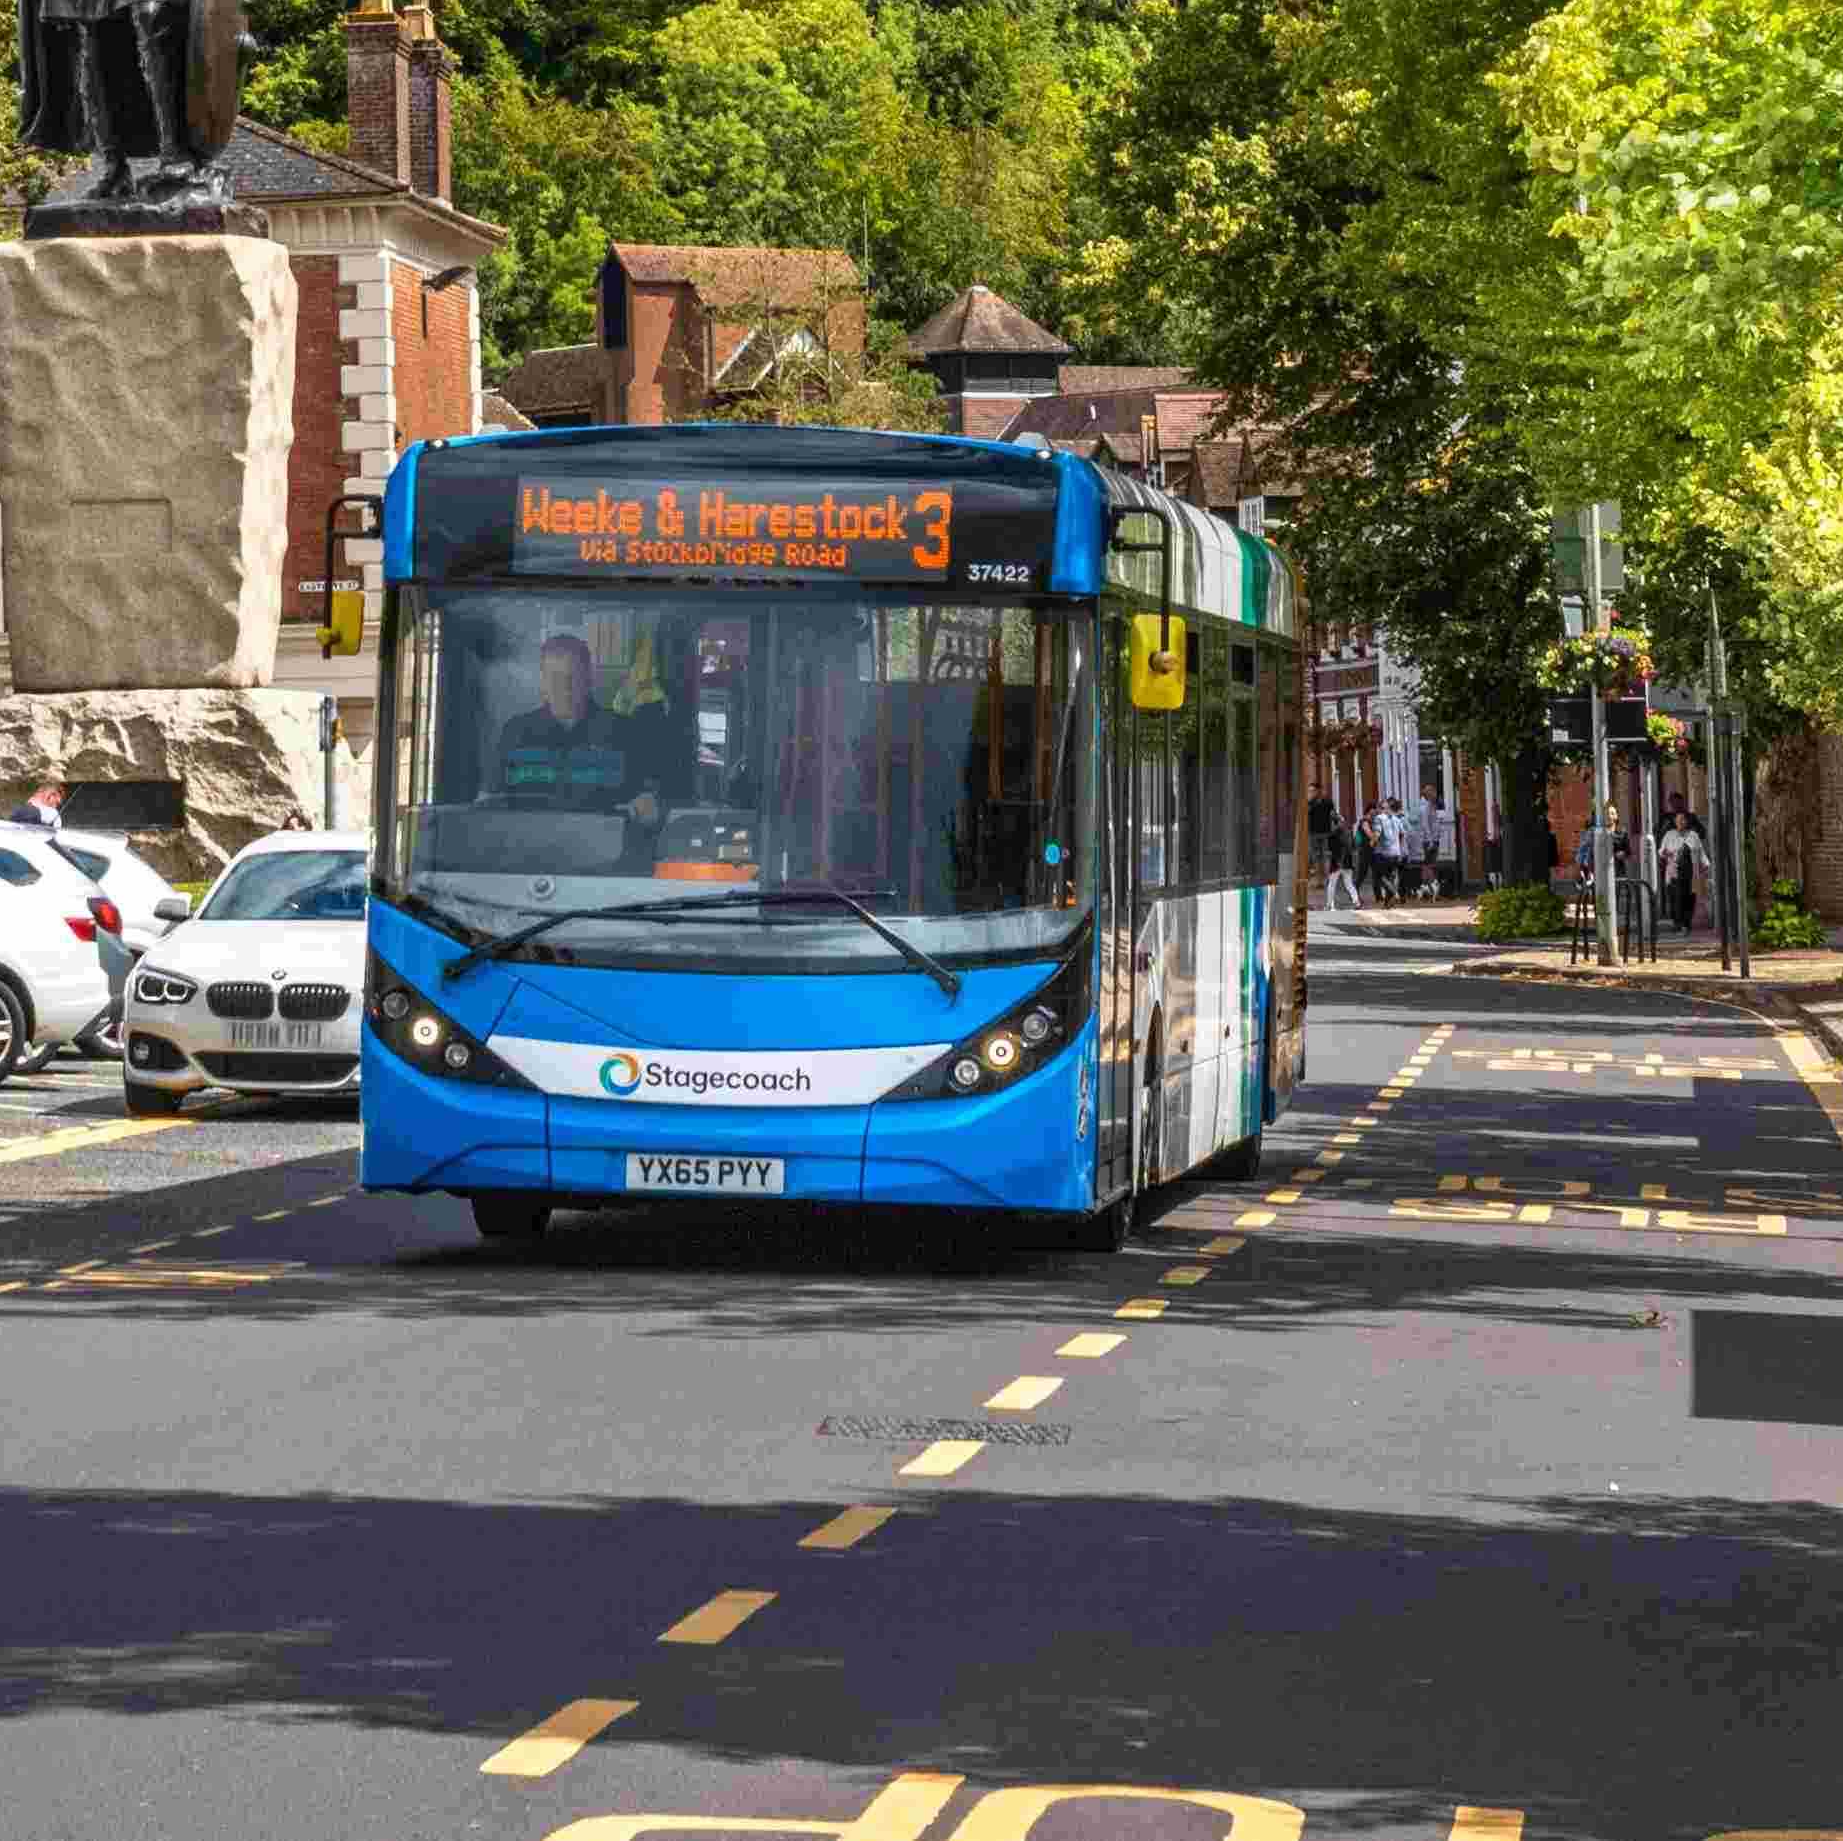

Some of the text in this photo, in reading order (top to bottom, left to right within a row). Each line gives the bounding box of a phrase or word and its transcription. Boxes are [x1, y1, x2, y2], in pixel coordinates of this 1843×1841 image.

[522, 487, 953, 570] Weeke & Harestock 3
[786, 541, 847, 568] Road
[968, 564, 1030, 583] 37422
[645, 1062, 812, 1094] Stagecoach
[638, 1157, 772, 1187] YX65 PYY
